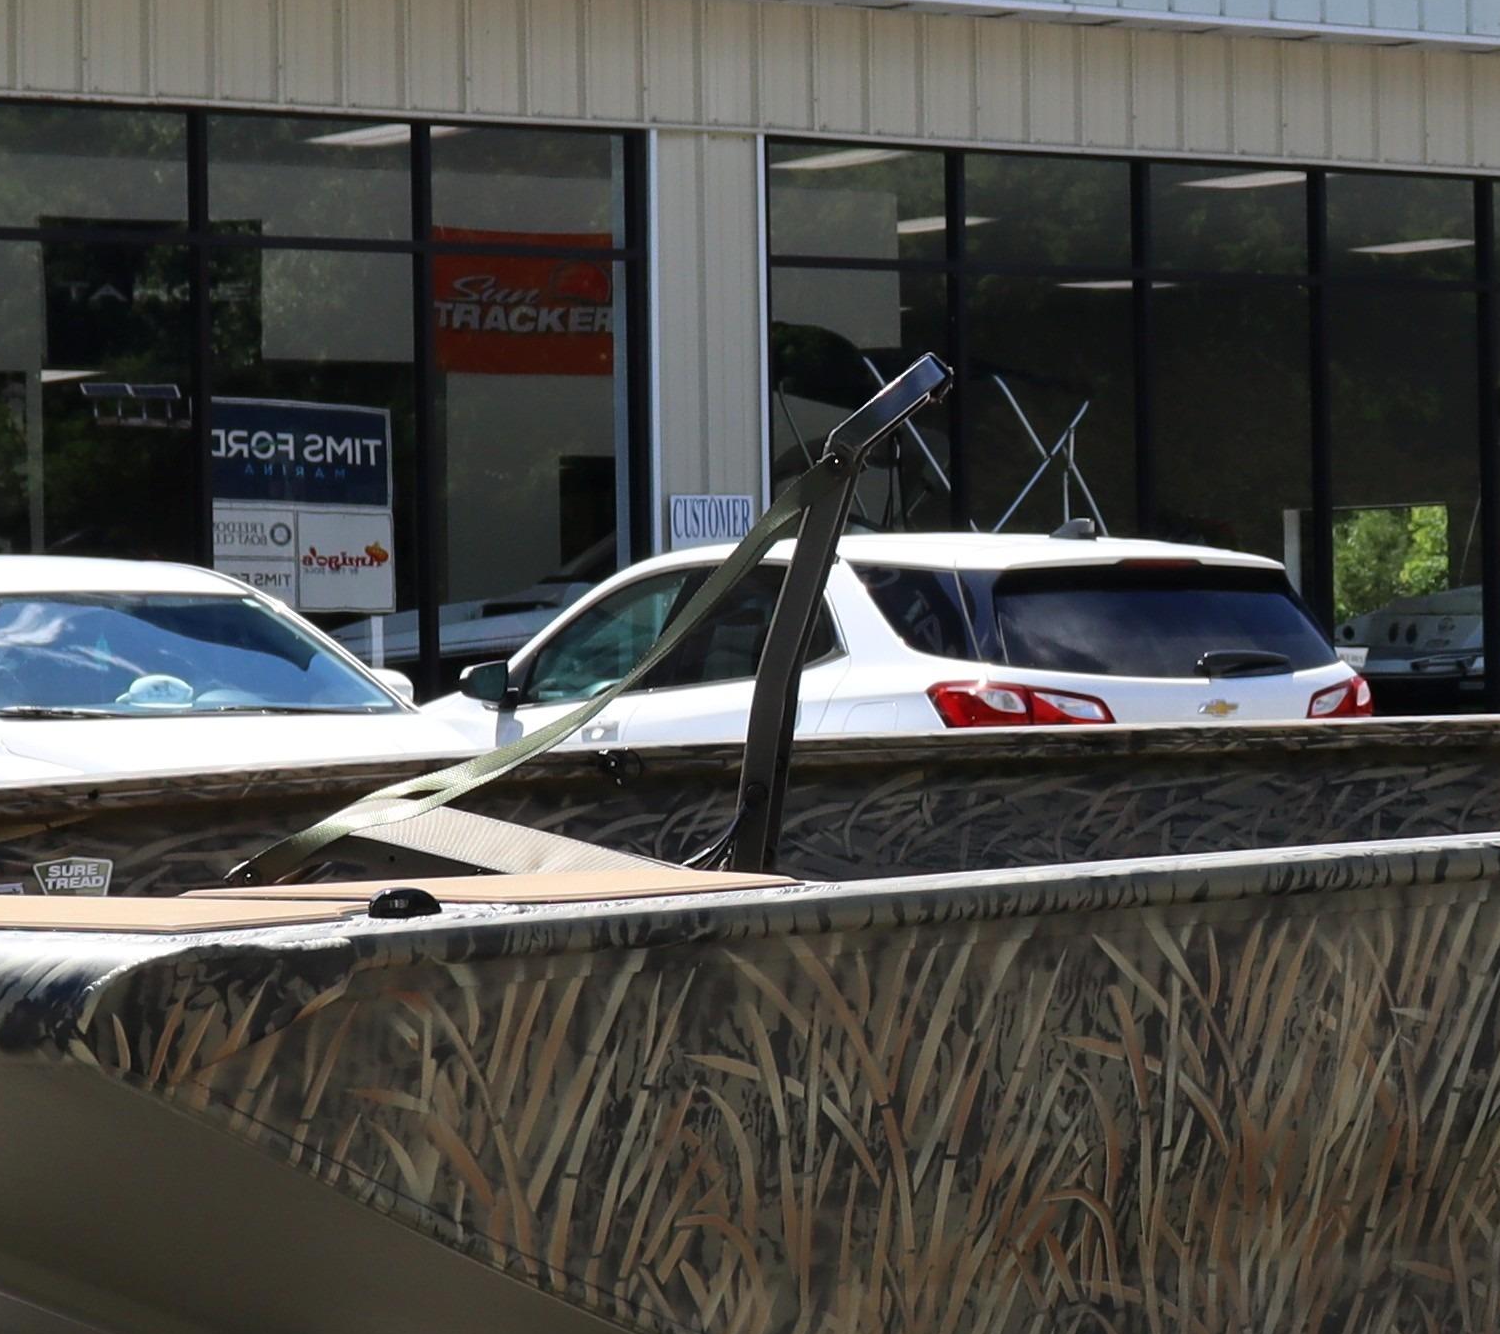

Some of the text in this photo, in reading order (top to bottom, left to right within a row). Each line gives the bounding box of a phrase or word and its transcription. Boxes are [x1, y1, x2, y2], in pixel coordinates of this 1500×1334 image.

[452, 275, 540, 304] Sun
[434, 300, 613, 332] TRACKER
[673, 497, 750, 539] CUSTOMER
[45, 875, 106, 890] TREAD
[48, 863, 99, 878] SURE
